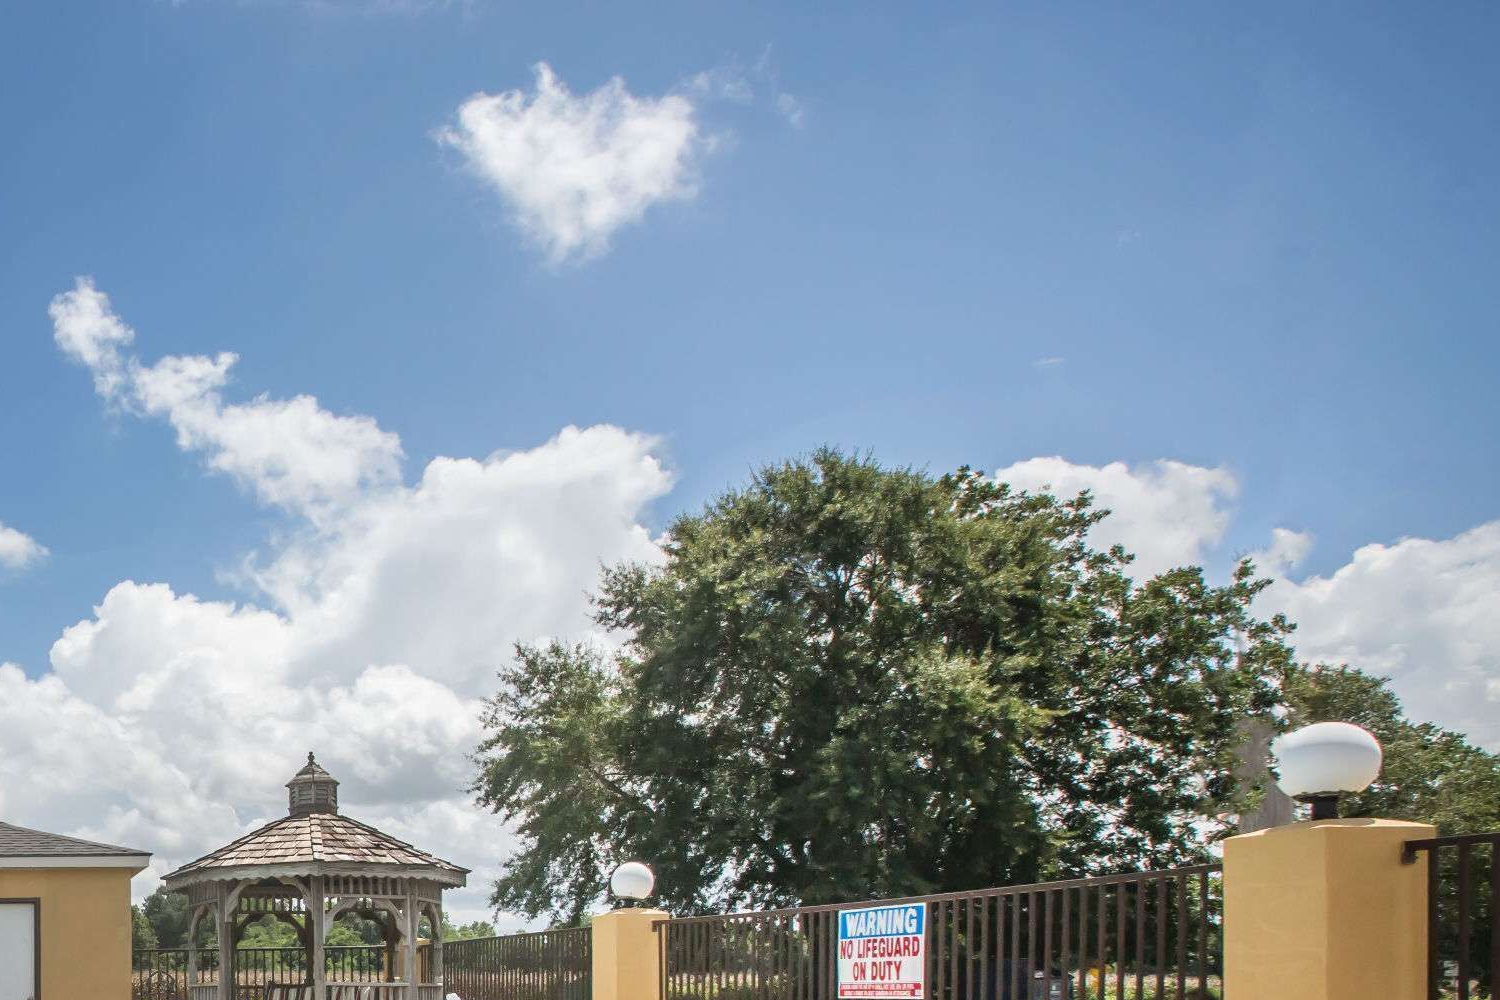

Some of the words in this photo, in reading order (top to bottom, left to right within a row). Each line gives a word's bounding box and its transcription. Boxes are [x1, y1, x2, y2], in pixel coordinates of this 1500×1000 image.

[846, 907, 917, 937] WARNING
[840, 940, 854, 959] NO
[858, 936, 920, 958] LIFEGUARD
[853, 962, 866, 981] ON
[871, 961, 902, 980] DUTY
